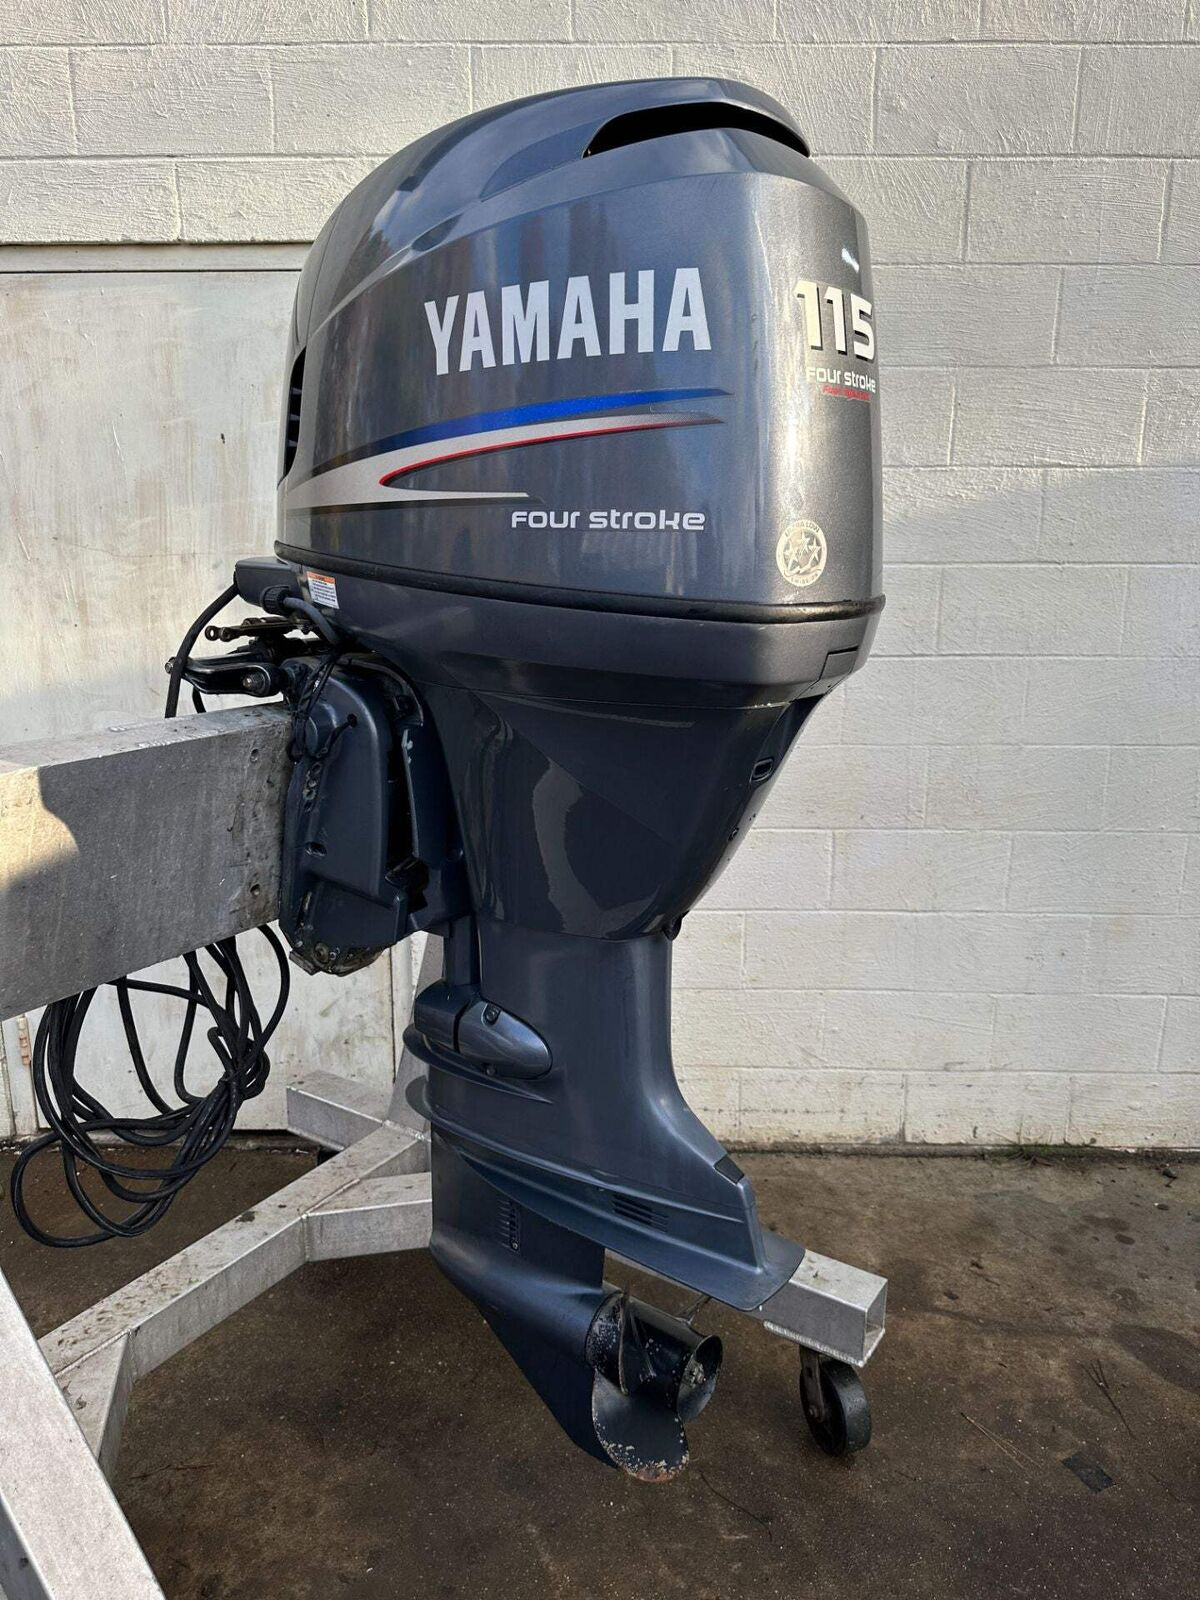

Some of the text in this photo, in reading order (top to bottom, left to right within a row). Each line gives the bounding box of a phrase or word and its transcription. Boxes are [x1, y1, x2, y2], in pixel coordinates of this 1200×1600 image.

[423, 267, 712, 376] YAMAHA
[793, 280, 875, 363] 115
[588, 509, 706, 531] stroke
